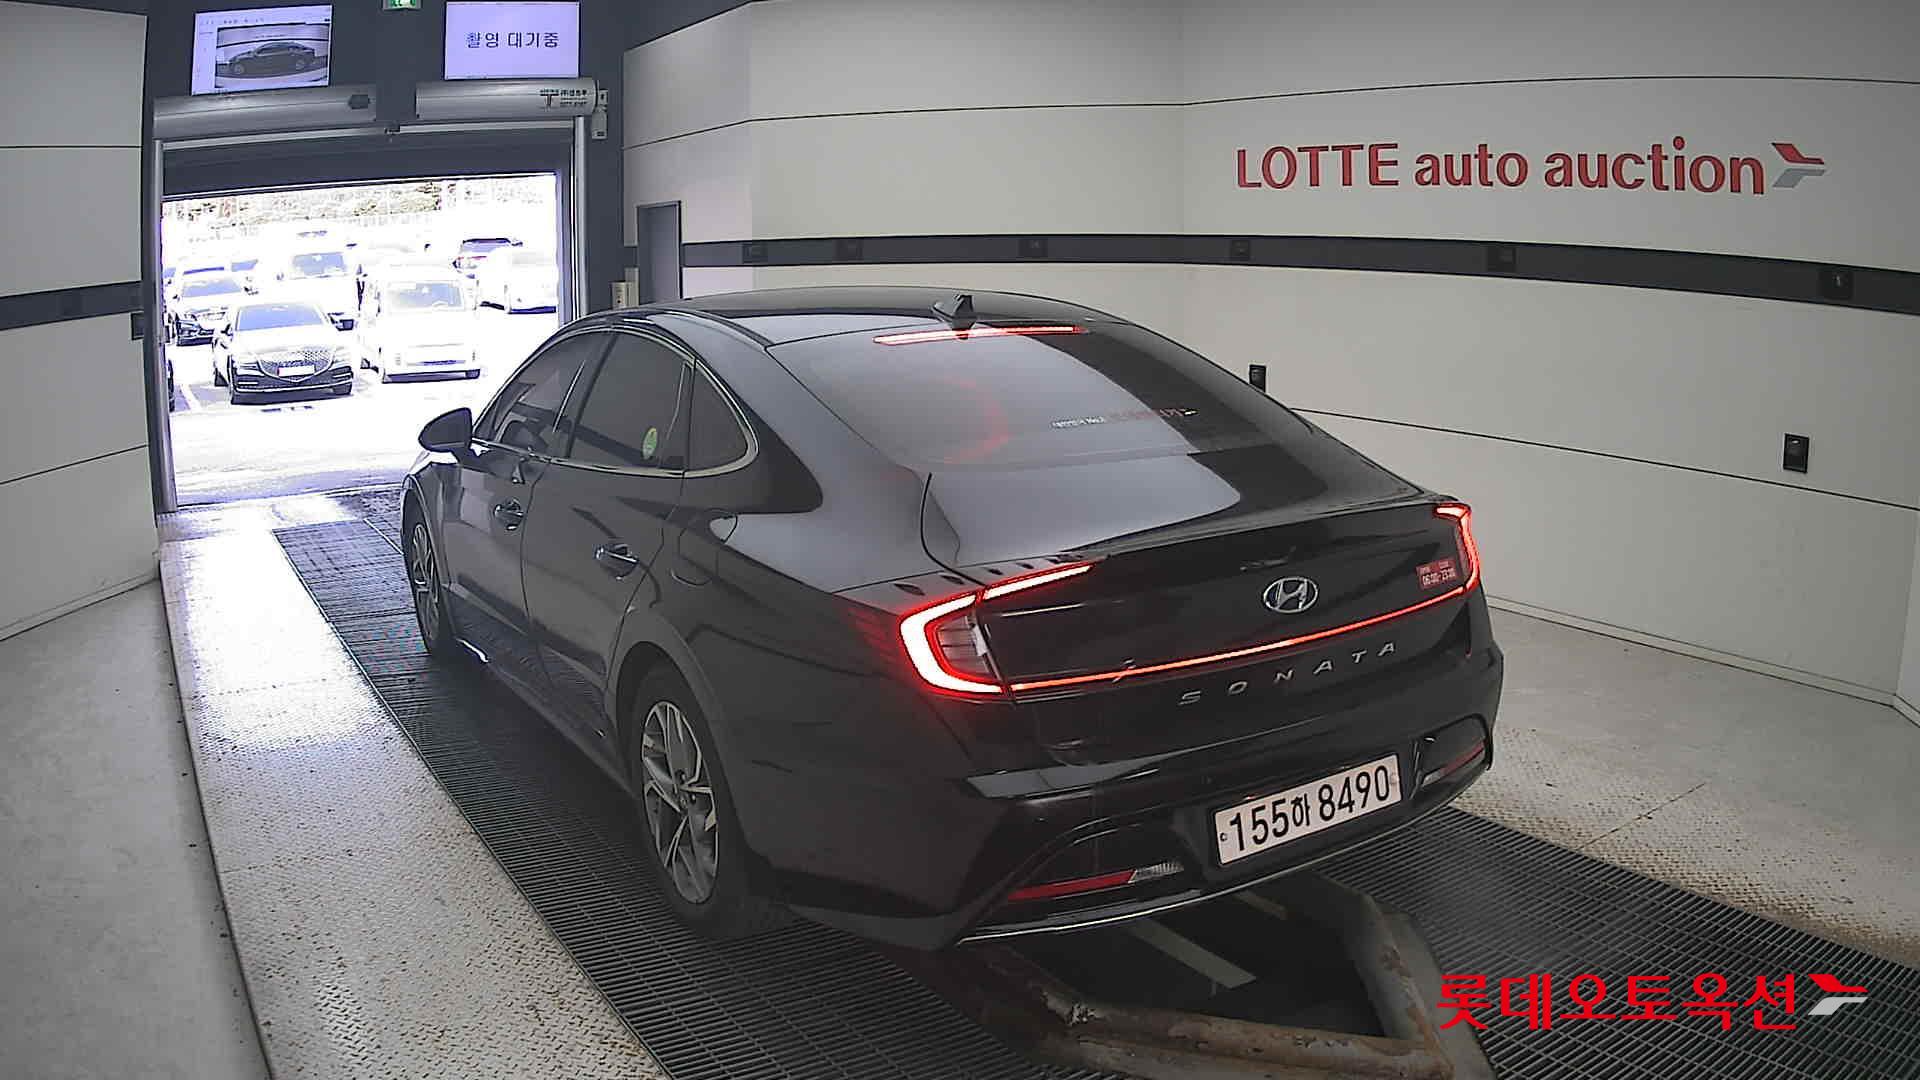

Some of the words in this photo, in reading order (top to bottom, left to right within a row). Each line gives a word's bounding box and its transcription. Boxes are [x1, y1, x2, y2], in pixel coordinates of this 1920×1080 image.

[507, 32, 559, 49] 대기중
[1237, 143, 1400, 189] LOTTE
[1414, 143, 1529, 188] auto
[1544, 135, 1765, 195] auction
[1178, 641, 1396, 706] SONATA
[1229, 793, 1311, 852] 155하
[1317, 764, 1390, 822] 8490
